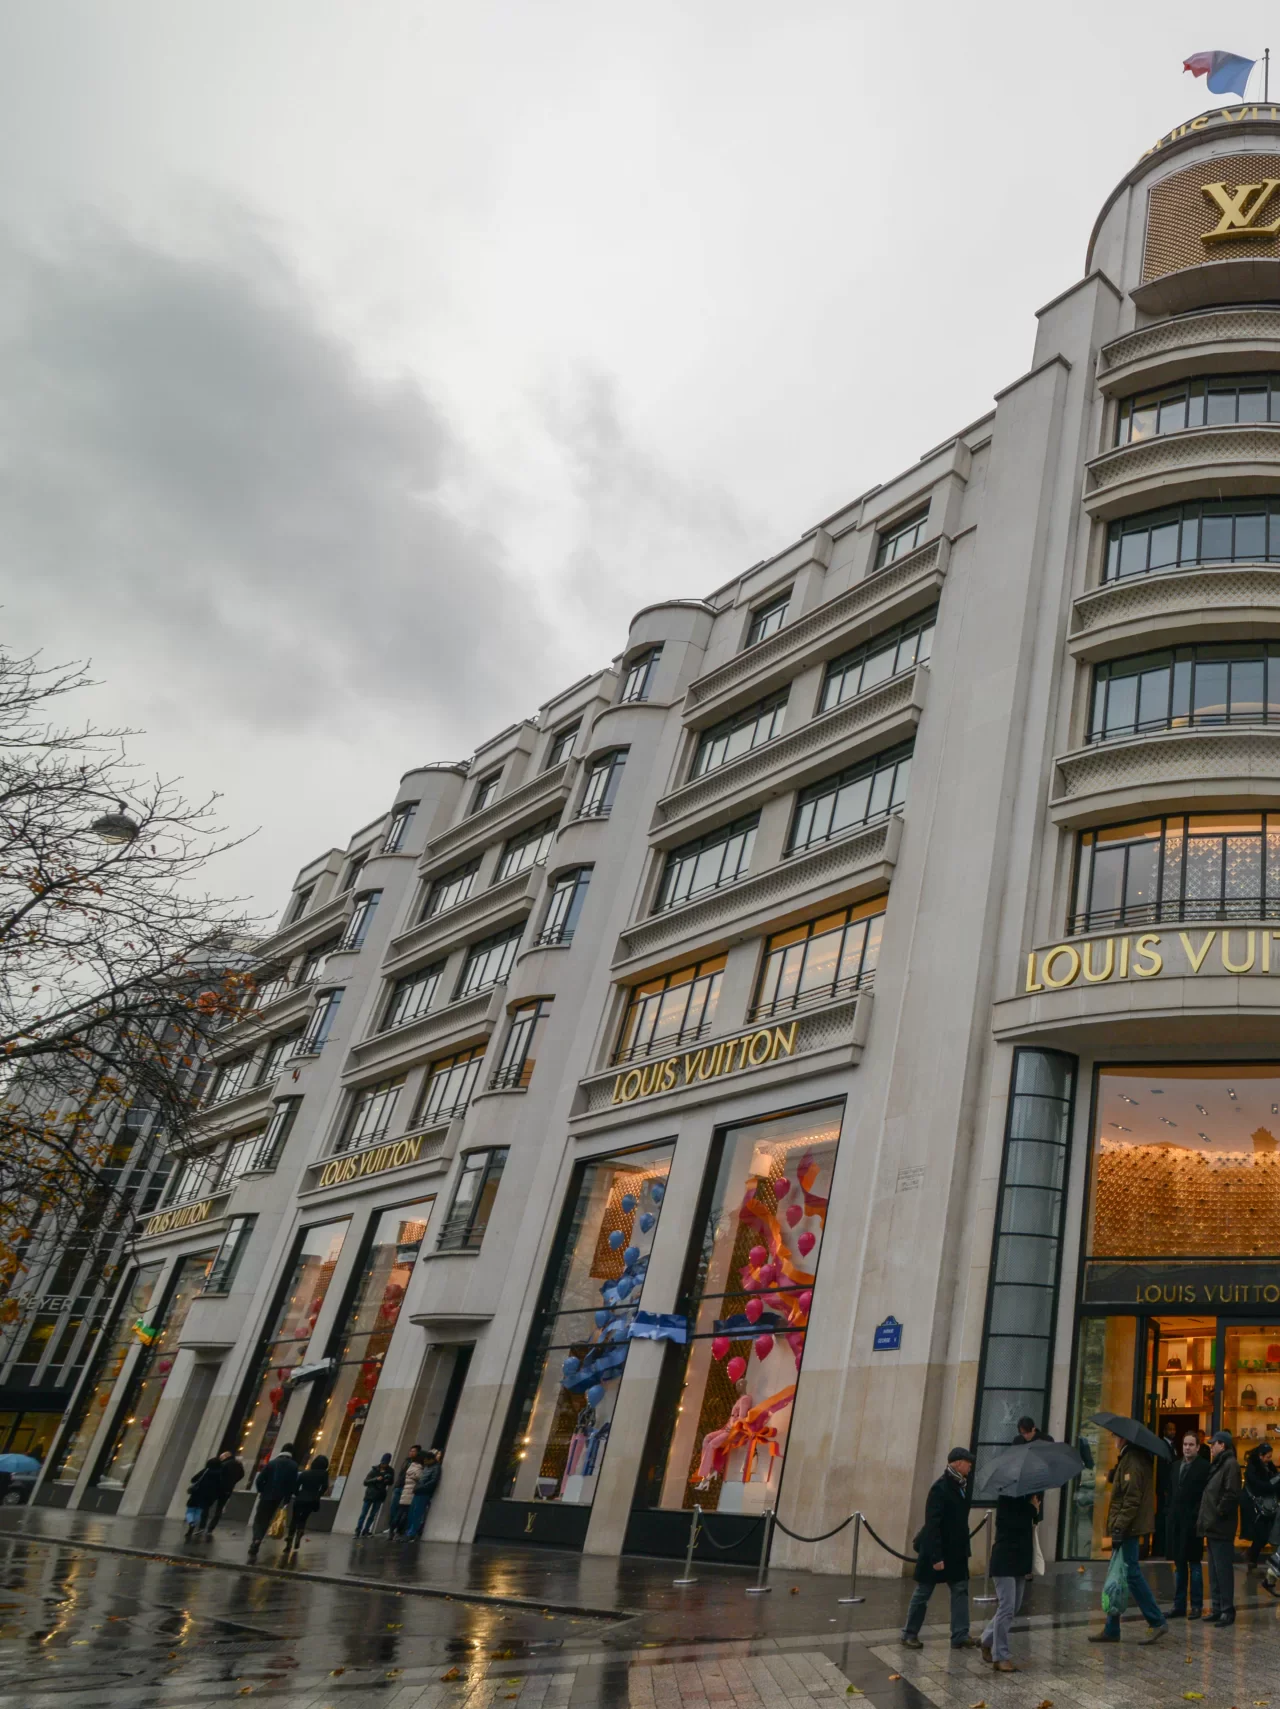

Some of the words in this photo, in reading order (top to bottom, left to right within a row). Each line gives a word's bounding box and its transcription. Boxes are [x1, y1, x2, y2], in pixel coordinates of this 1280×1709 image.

[1025, 933, 1164, 993] LOUIS
[611, 1057, 680, 1105] LOUIS
[684, 1021, 800, 1085] VUITTON
[319, 1154, 360, 1187] LOUIS
[359, 1135, 423, 1176] VUITTON
[145, 1211, 173, 1236] LOUIS
[169, 1200, 213, 1230] VUITTON
[1136, 1284, 1196, 1303] LOUIS
